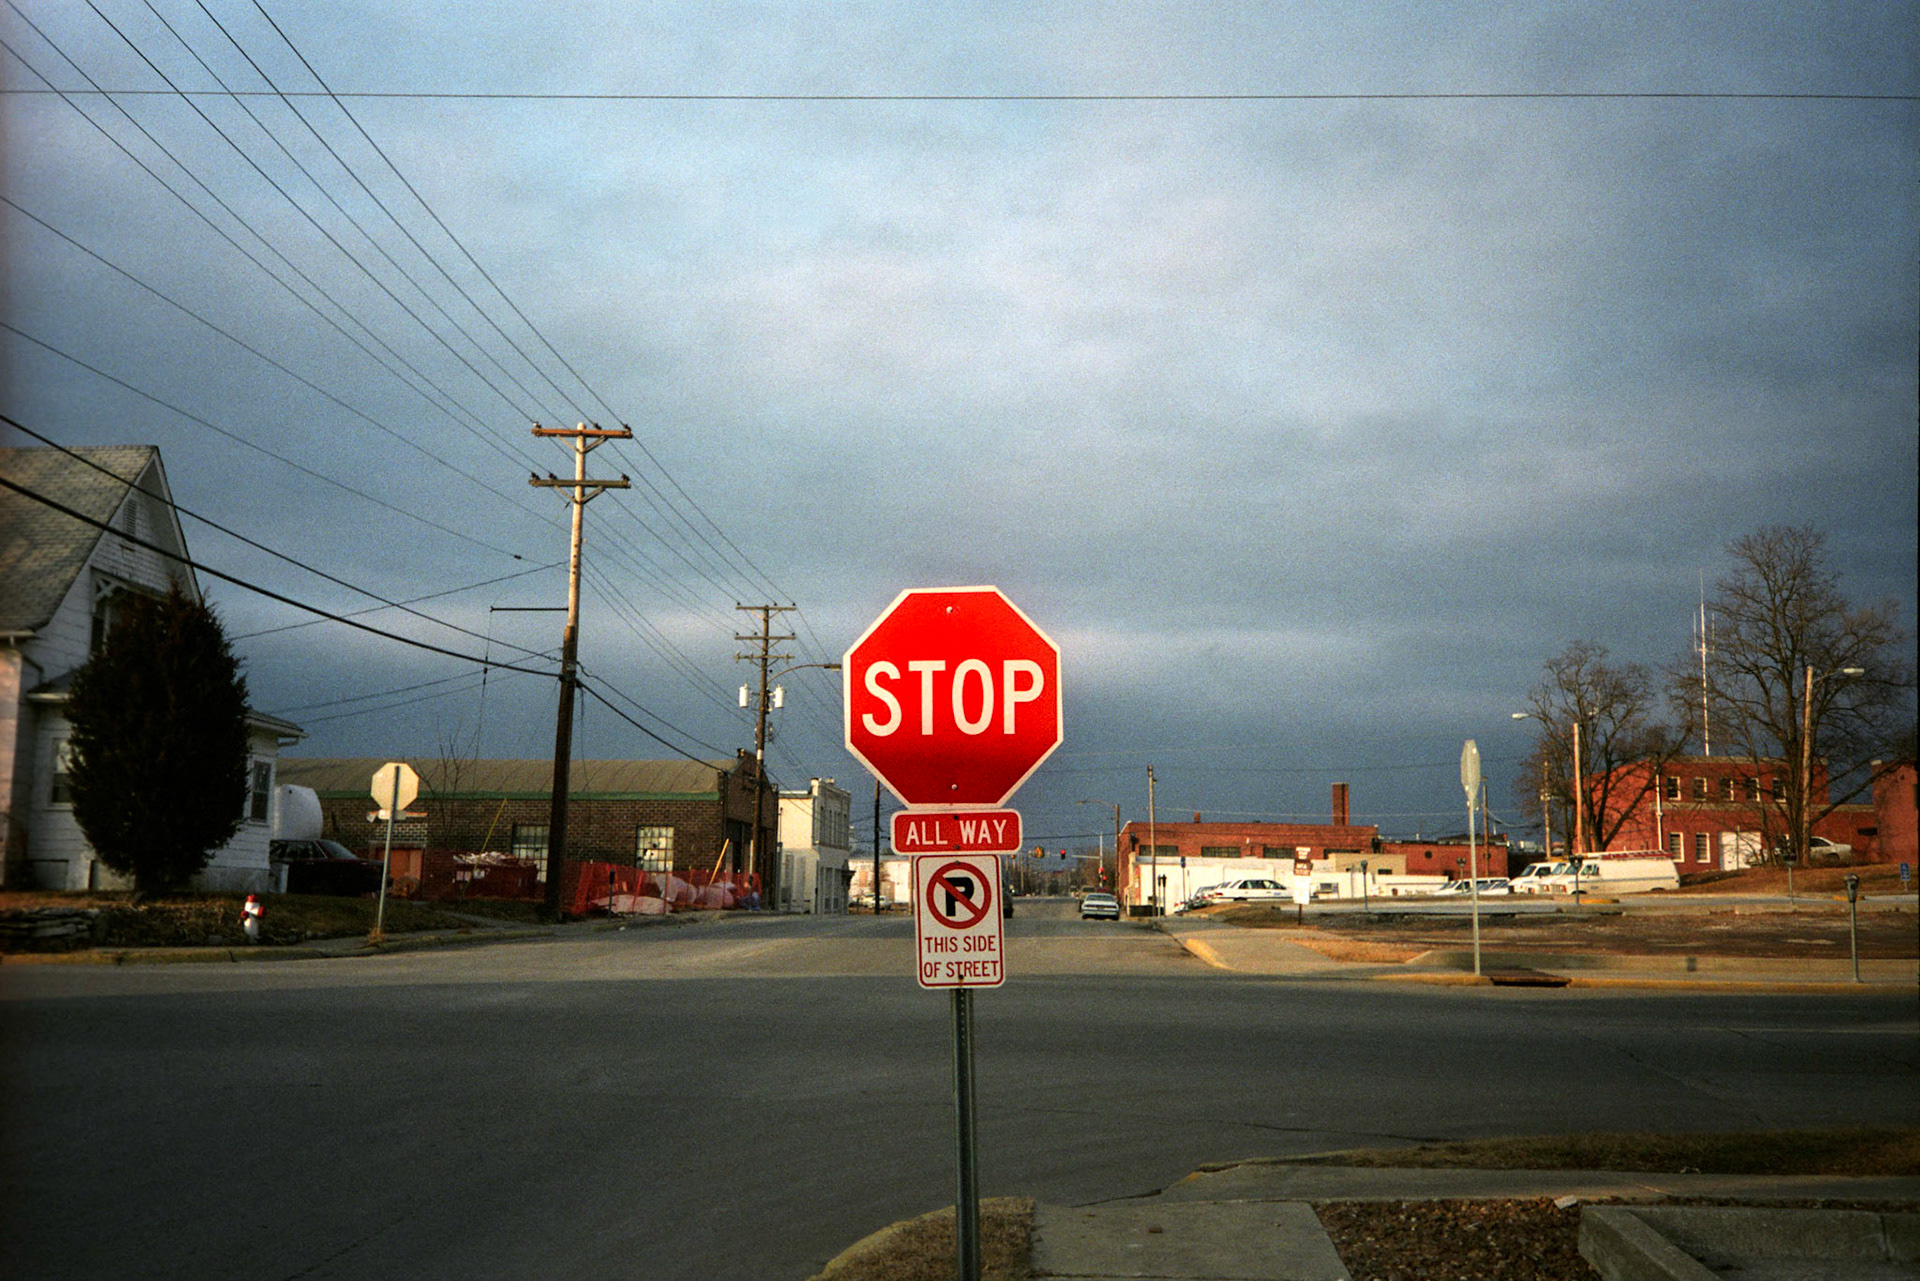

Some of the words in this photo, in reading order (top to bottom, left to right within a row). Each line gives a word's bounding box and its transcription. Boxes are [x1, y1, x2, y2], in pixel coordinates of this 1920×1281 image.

[862, 658, 1045, 737] STOP
[905, 821, 948, 846] ALL
[959, 819, 1007, 845] WAY
[945, 877, 975, 917] P
[924, 936, 958, 953] THIS
[963, 935, 996, 952] SIDE
[924, 962, 942, 978] OF
[946, 961, 999, 978] STREET
